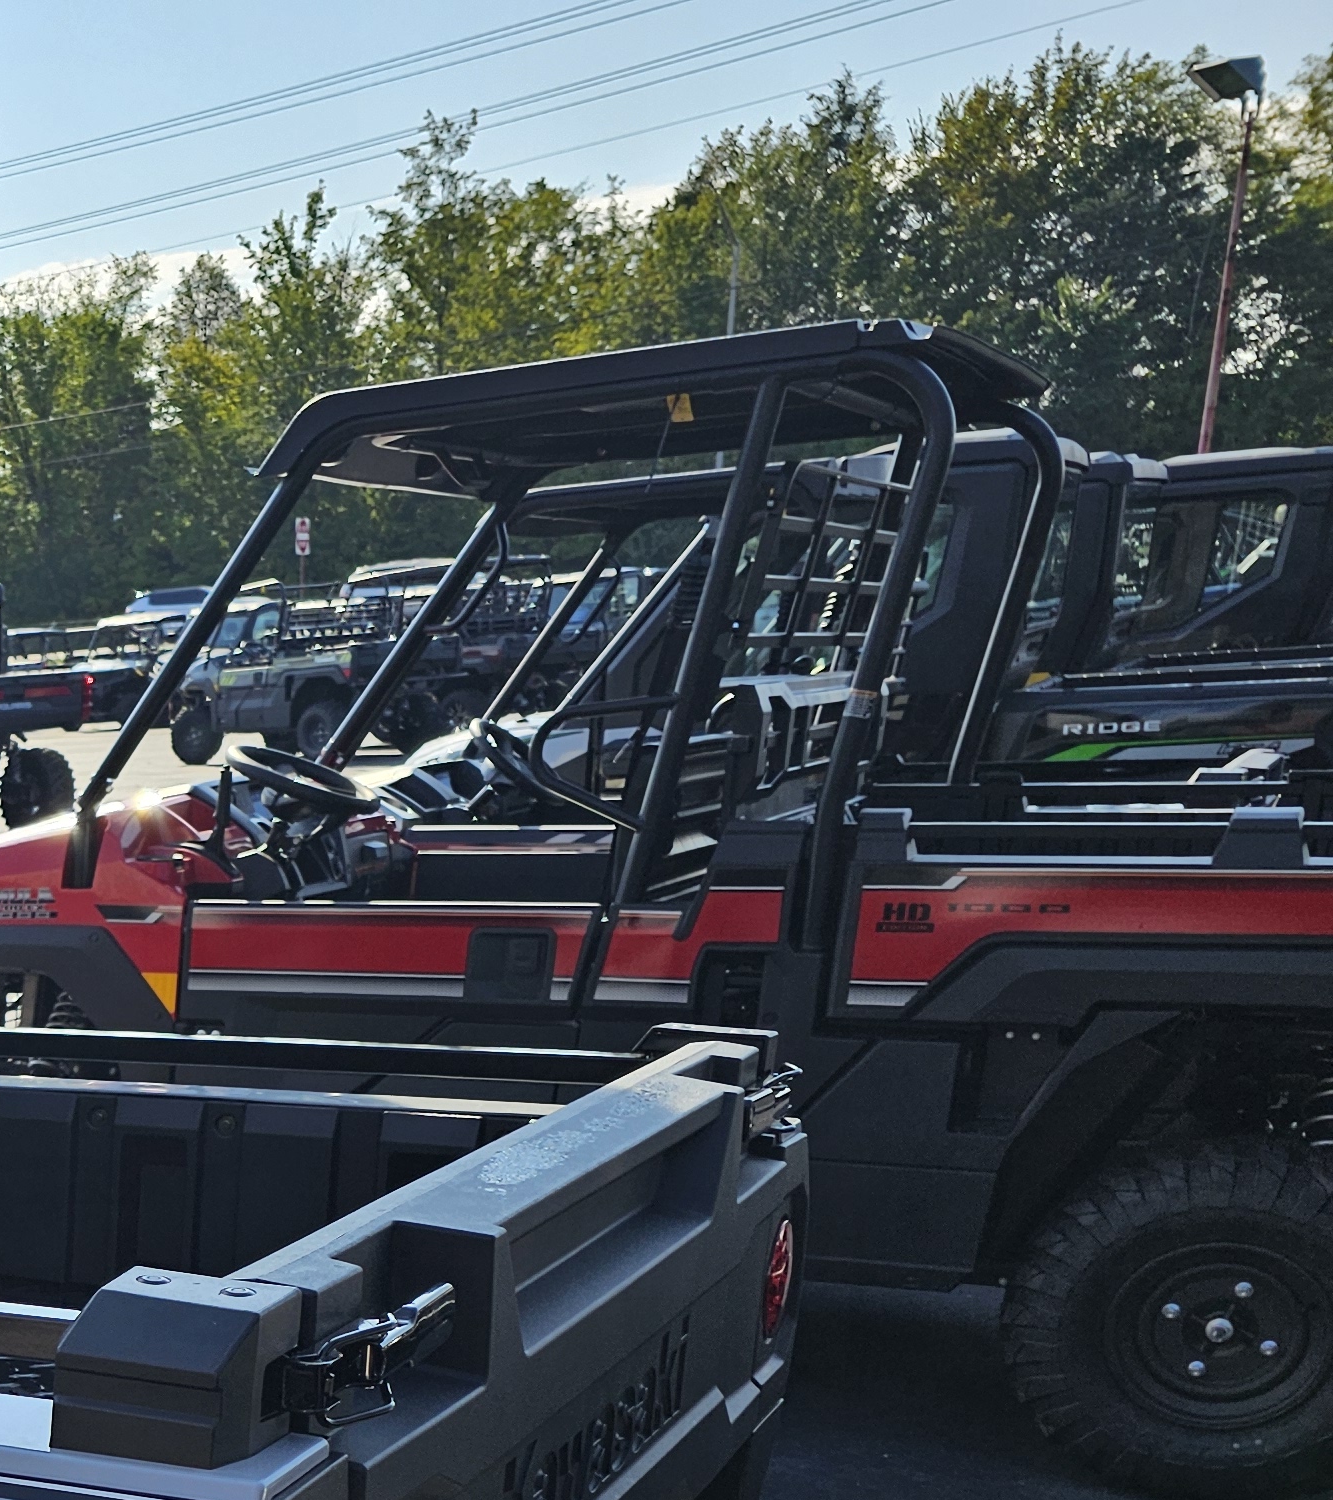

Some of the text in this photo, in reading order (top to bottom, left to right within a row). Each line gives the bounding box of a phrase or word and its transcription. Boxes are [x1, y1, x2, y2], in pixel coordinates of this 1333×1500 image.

[1063, 720, 1162, 735] RIDGE
[883, 903, 931, 921] HD
[947, 903, 1071, 914] 1000
